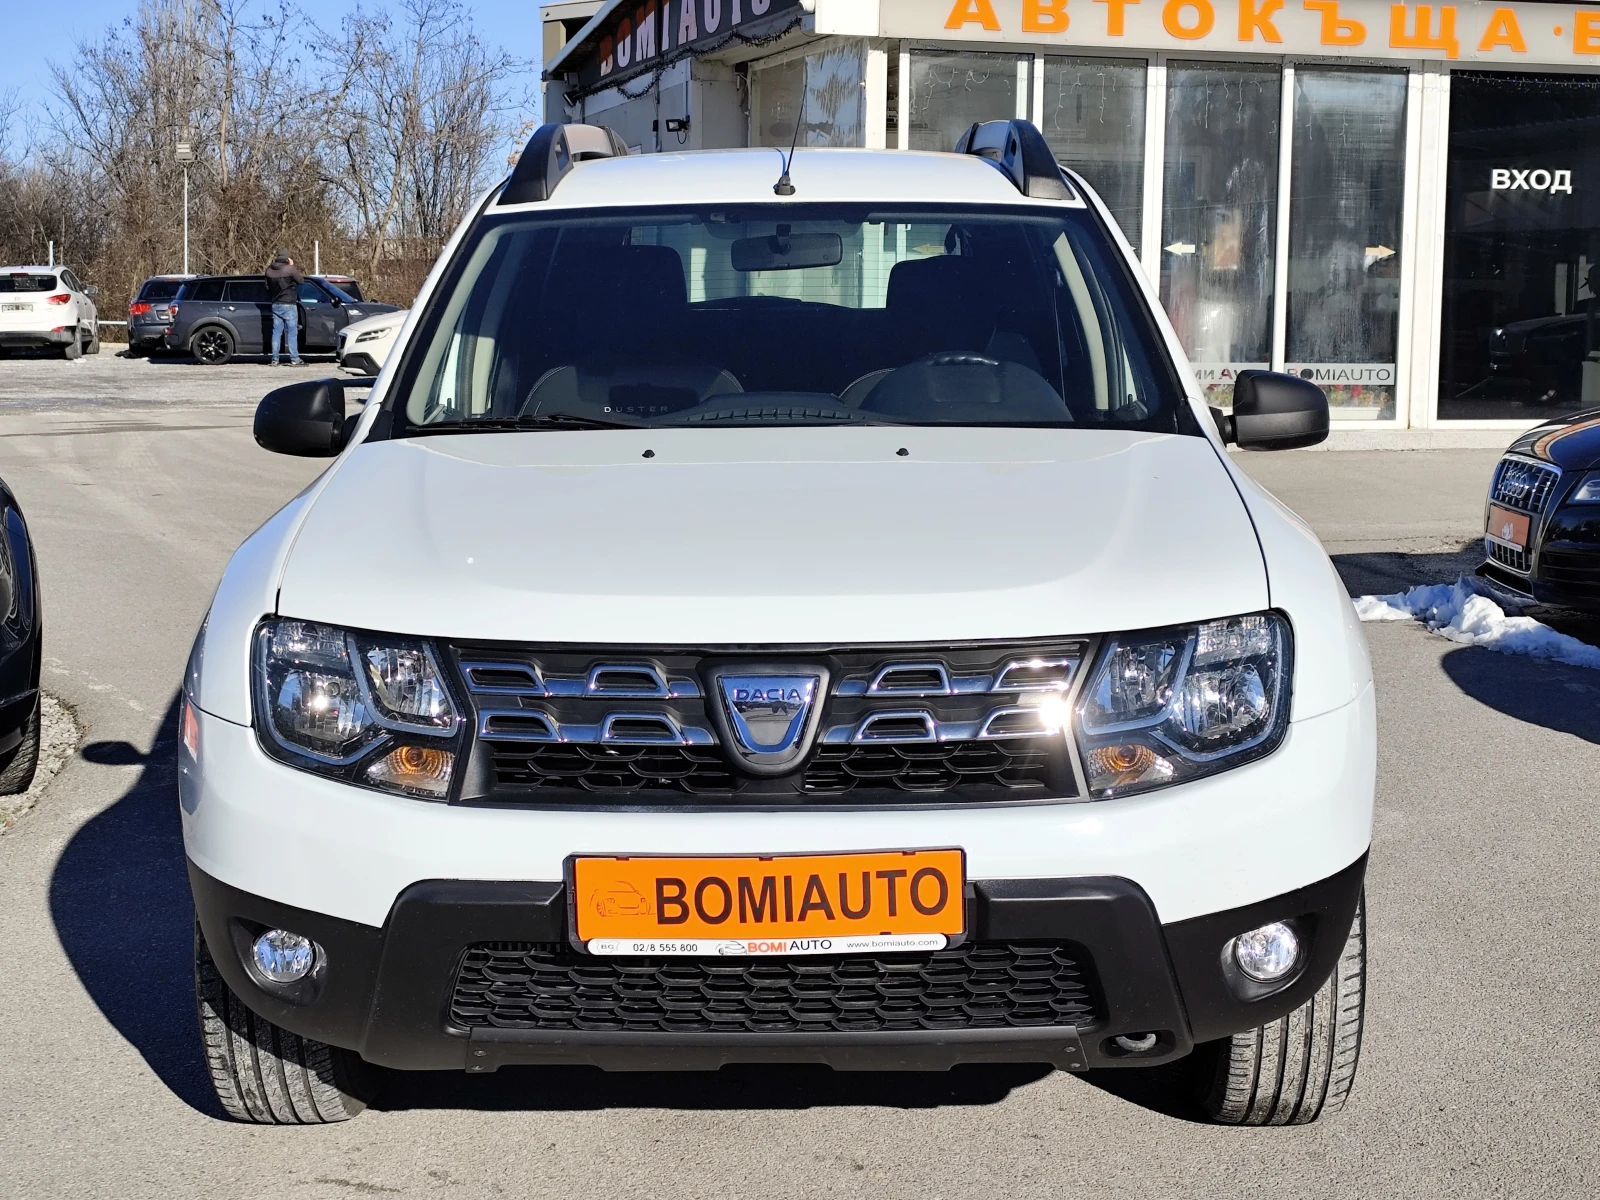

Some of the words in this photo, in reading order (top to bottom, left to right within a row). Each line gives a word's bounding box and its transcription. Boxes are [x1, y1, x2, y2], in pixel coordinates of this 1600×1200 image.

[1491, 168, 1573, 195] ВХОД
[733, 688, 801, 701] DACIA
[656, 867, 949, 925] BOMIAUTO
[633, 943, 656, 953] 02/8
[659, 943, 677, 952] 555
[680, 943, 698, 952] 800
[747, 942, 787, 953] BOMI
[789, 939, 832, 951] AUTO
[846, 939, 938, 948] www.bomiauto.com
